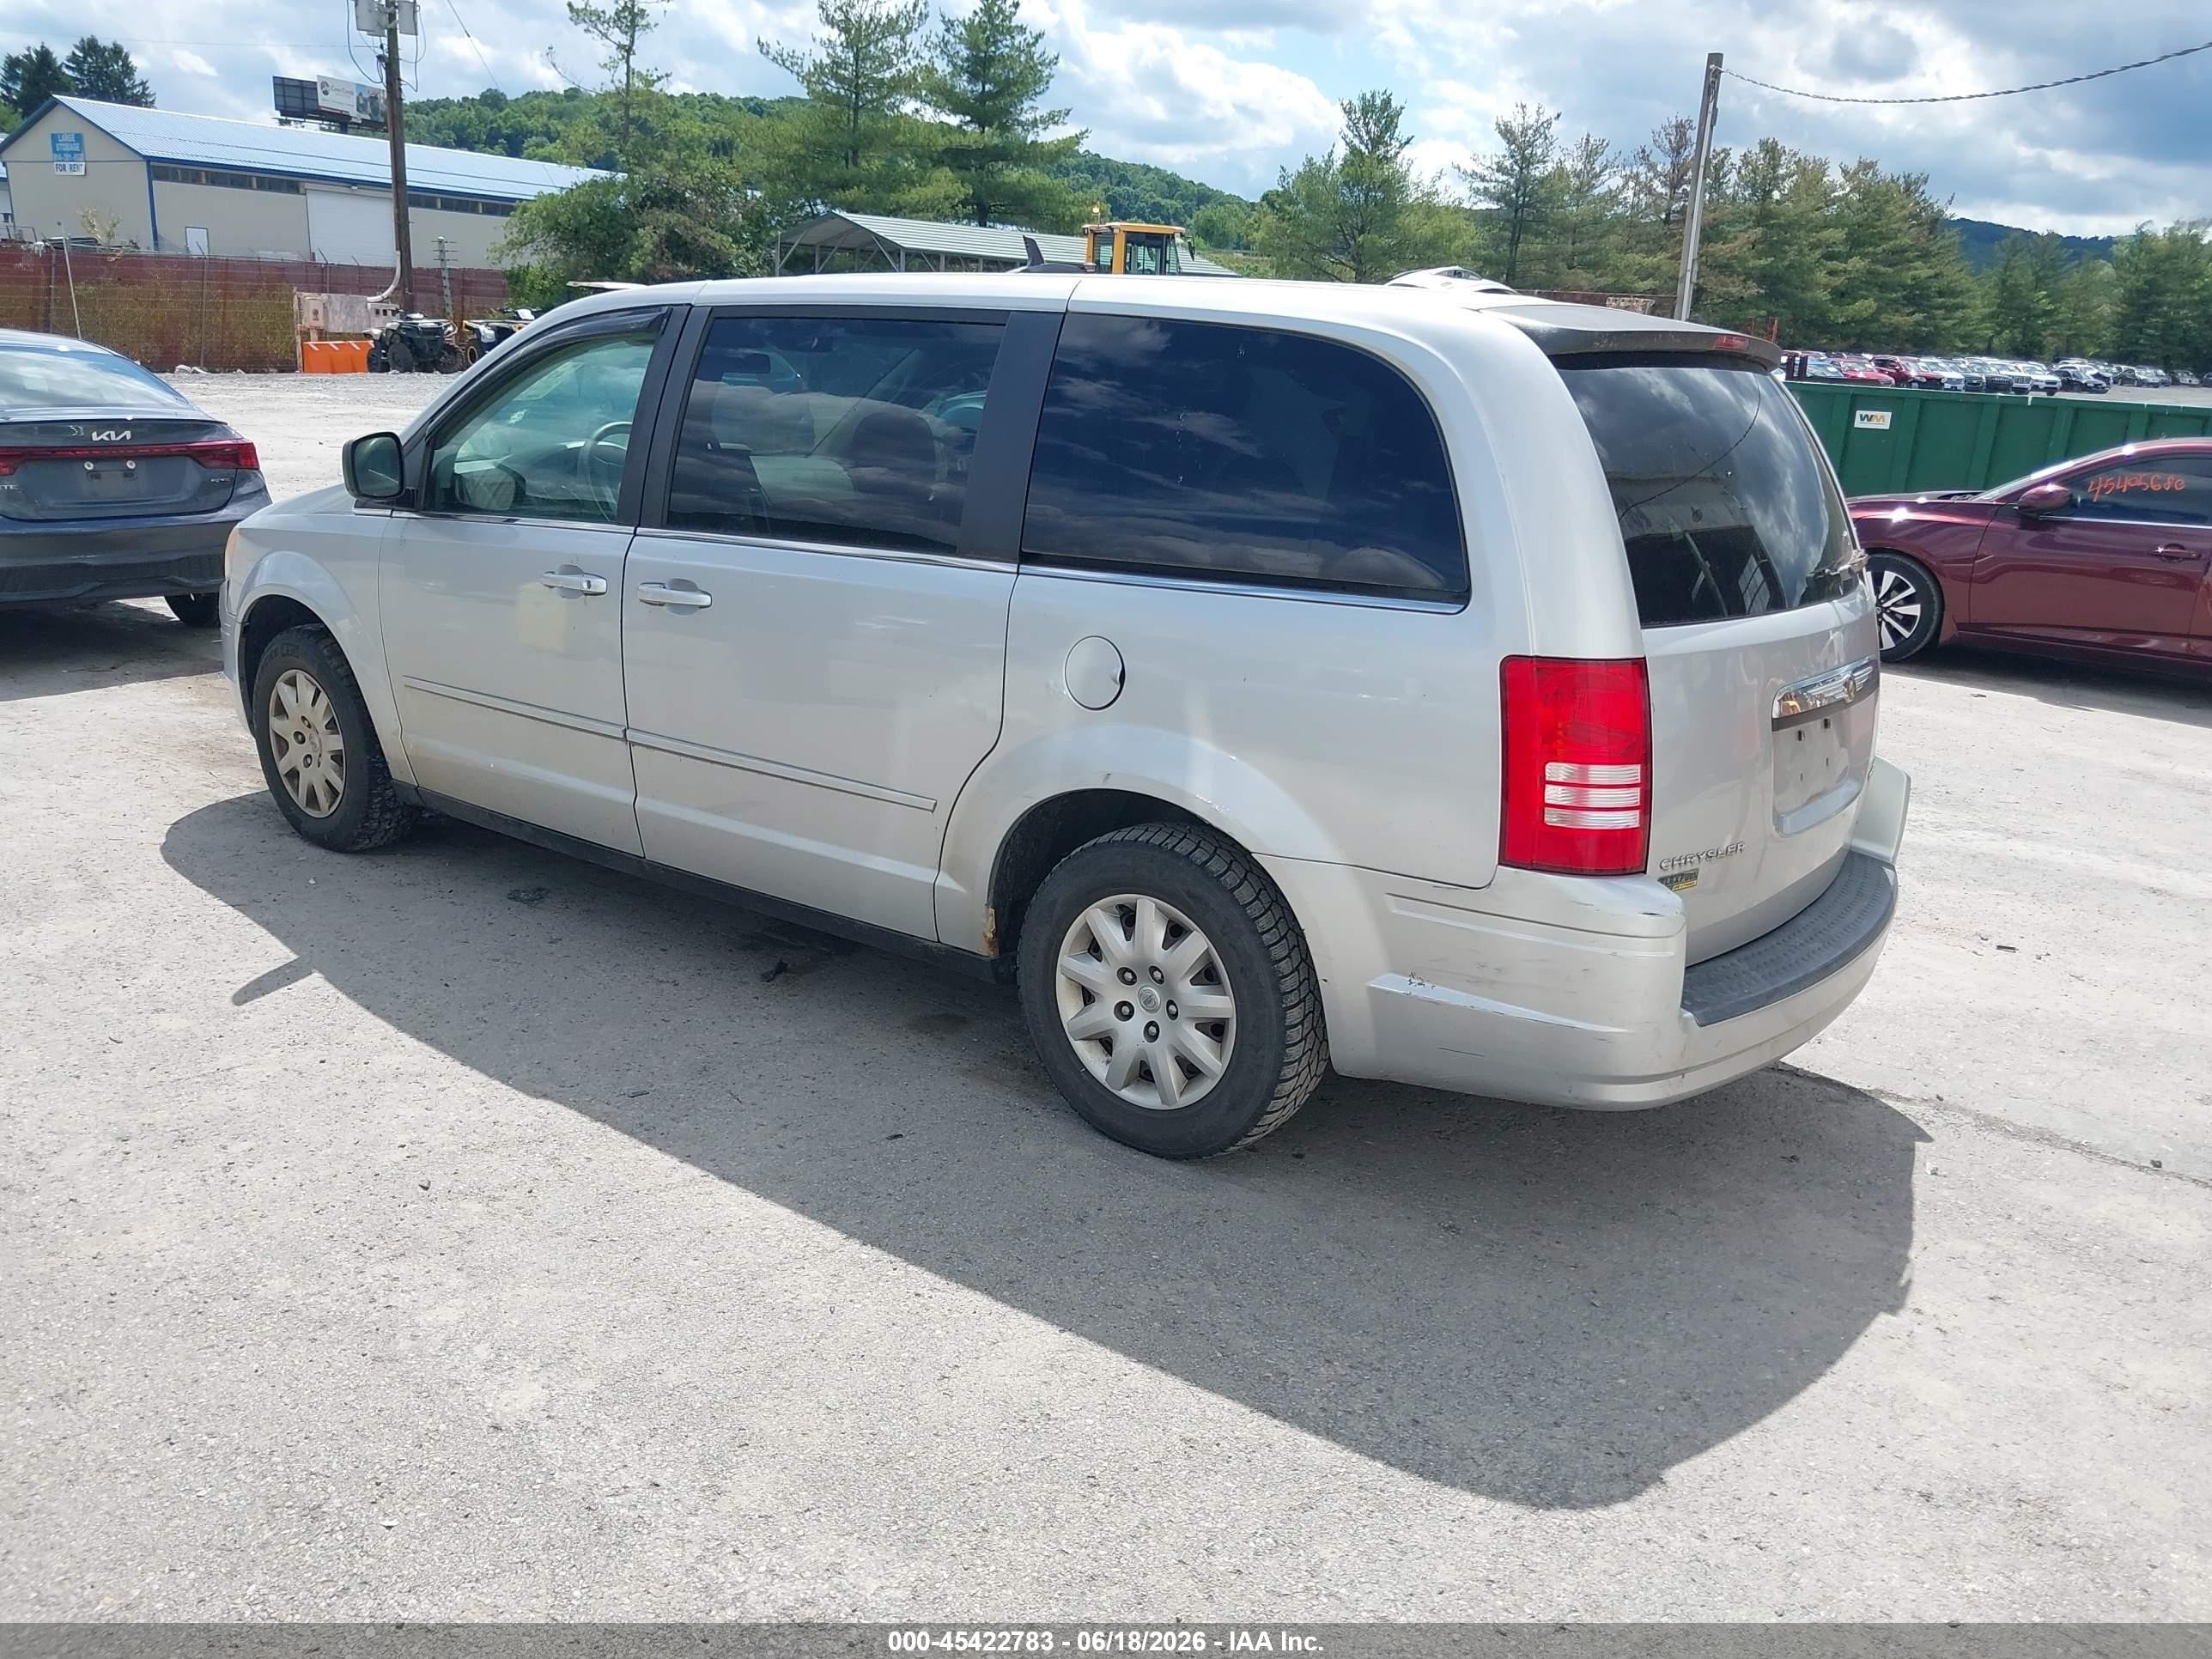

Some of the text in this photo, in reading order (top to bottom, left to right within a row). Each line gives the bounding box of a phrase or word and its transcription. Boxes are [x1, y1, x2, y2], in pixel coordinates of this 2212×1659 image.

[58, 133, 76, 142] LARGE
[56, 143, 81, 151] STORAGE
[55, 163, 83, 173] FOR RENT
[1859, 413, 1886, 422] WM
[91, 430, 131, 441] KIA
[1659, 842, 1746, 871] CHRYSLER
